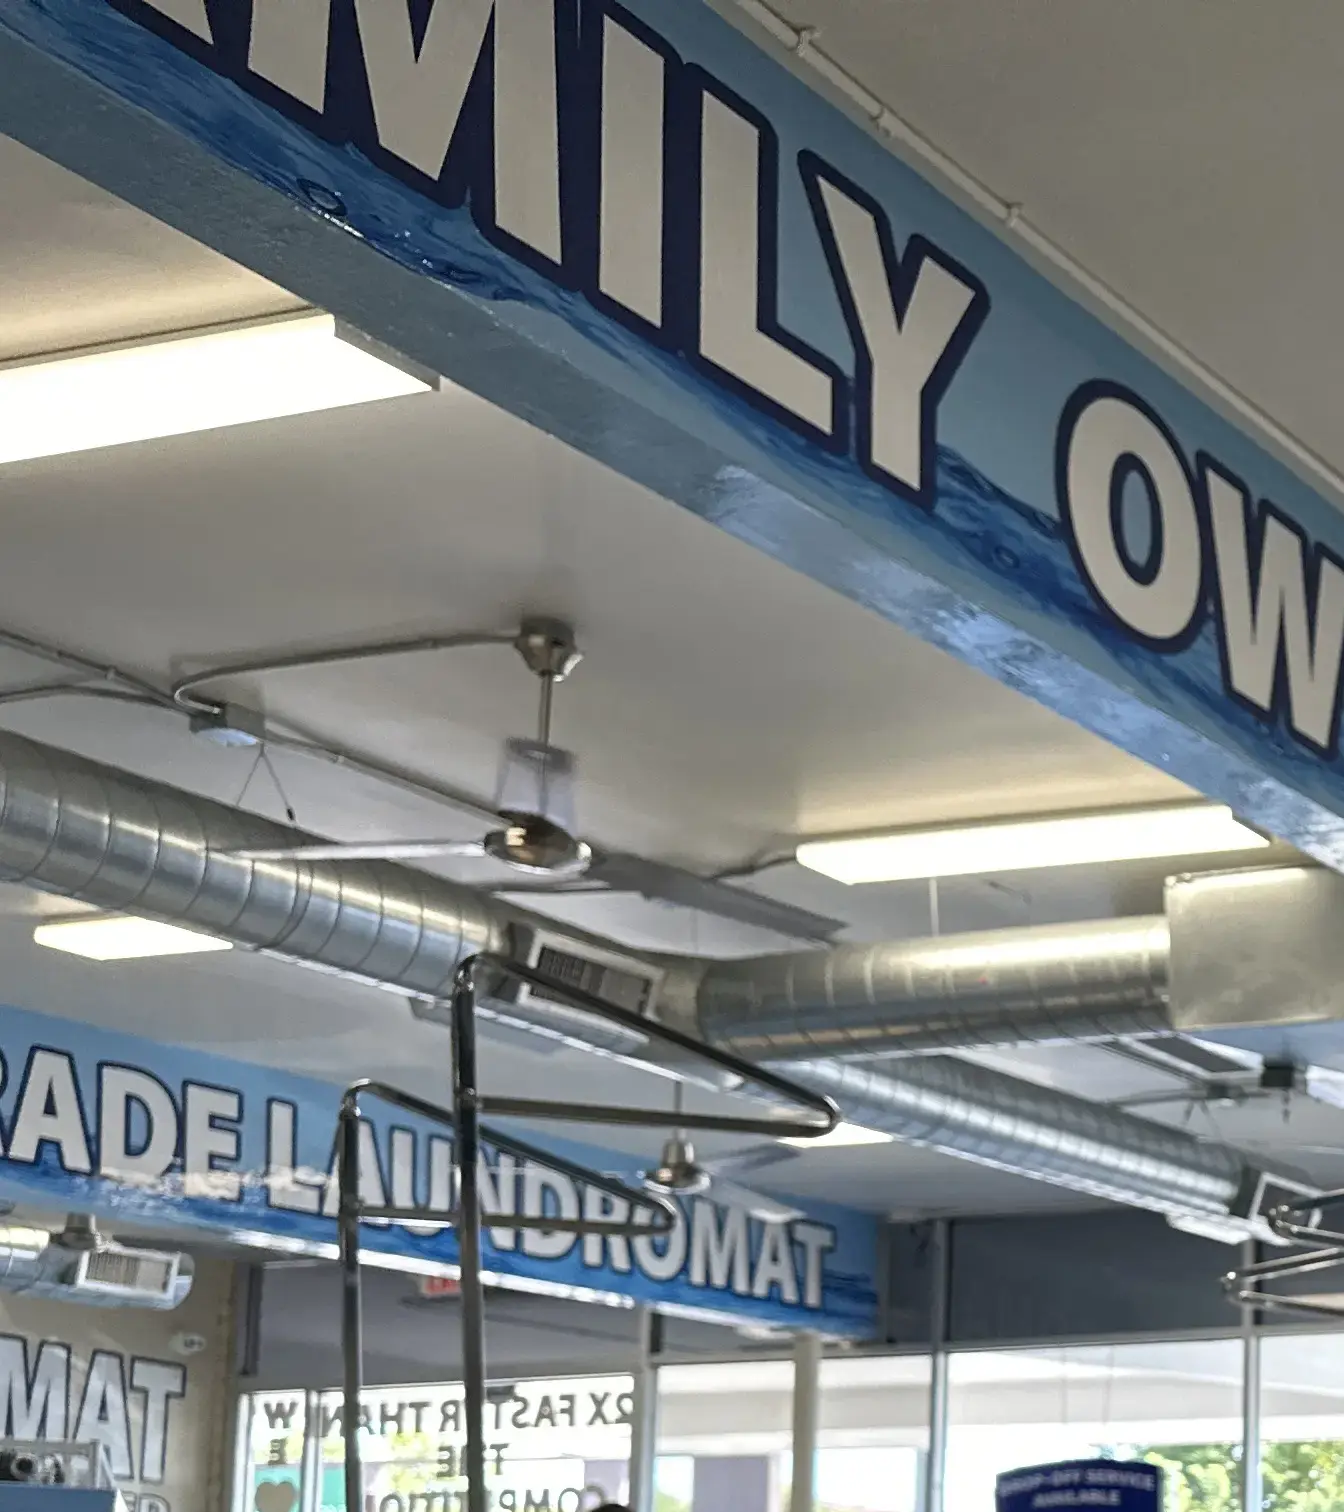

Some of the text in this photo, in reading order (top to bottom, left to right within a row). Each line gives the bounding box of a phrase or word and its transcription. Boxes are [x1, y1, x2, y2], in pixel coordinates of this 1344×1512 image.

[105, 0, 985, 505] MILY
[0, 1044, 837, 1309] ADE LAUNDROMAT
